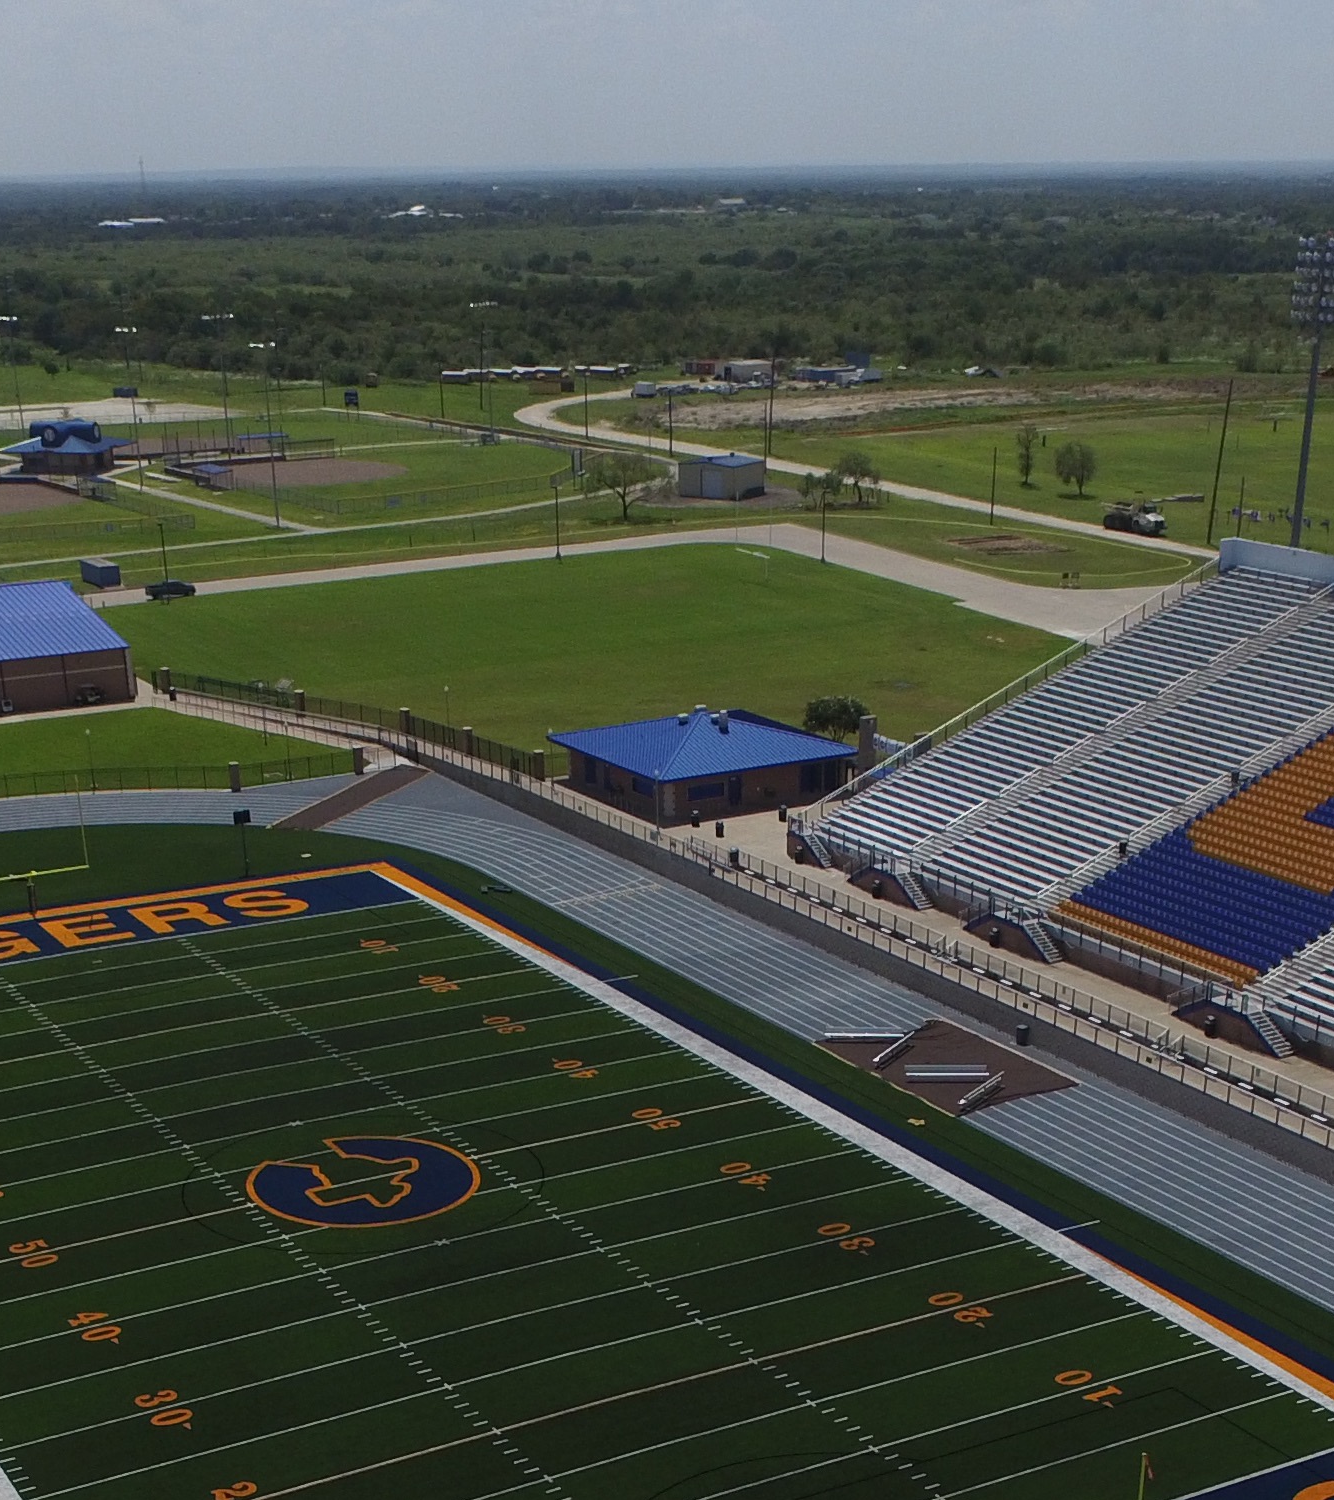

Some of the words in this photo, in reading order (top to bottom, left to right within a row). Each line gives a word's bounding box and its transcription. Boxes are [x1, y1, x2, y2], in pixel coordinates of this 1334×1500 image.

[420, 975, 459, 993] 20
[486, 1015, 526, 1034] 30
[553, 1058, 599, 1079] 40
[632, 1107, 681, 1130] 50
[720, 1162, 772, 1187] 40
[817, 1222, 876, 1251] 30
[9, 1238, 59, 1268] 50
[928, 1291, 994, 1324] 20
[67, 1311, 123, 1343] 40
[1054, 1369, 1123, 1404] 10
[134, 1389, 194, 1426] 30
